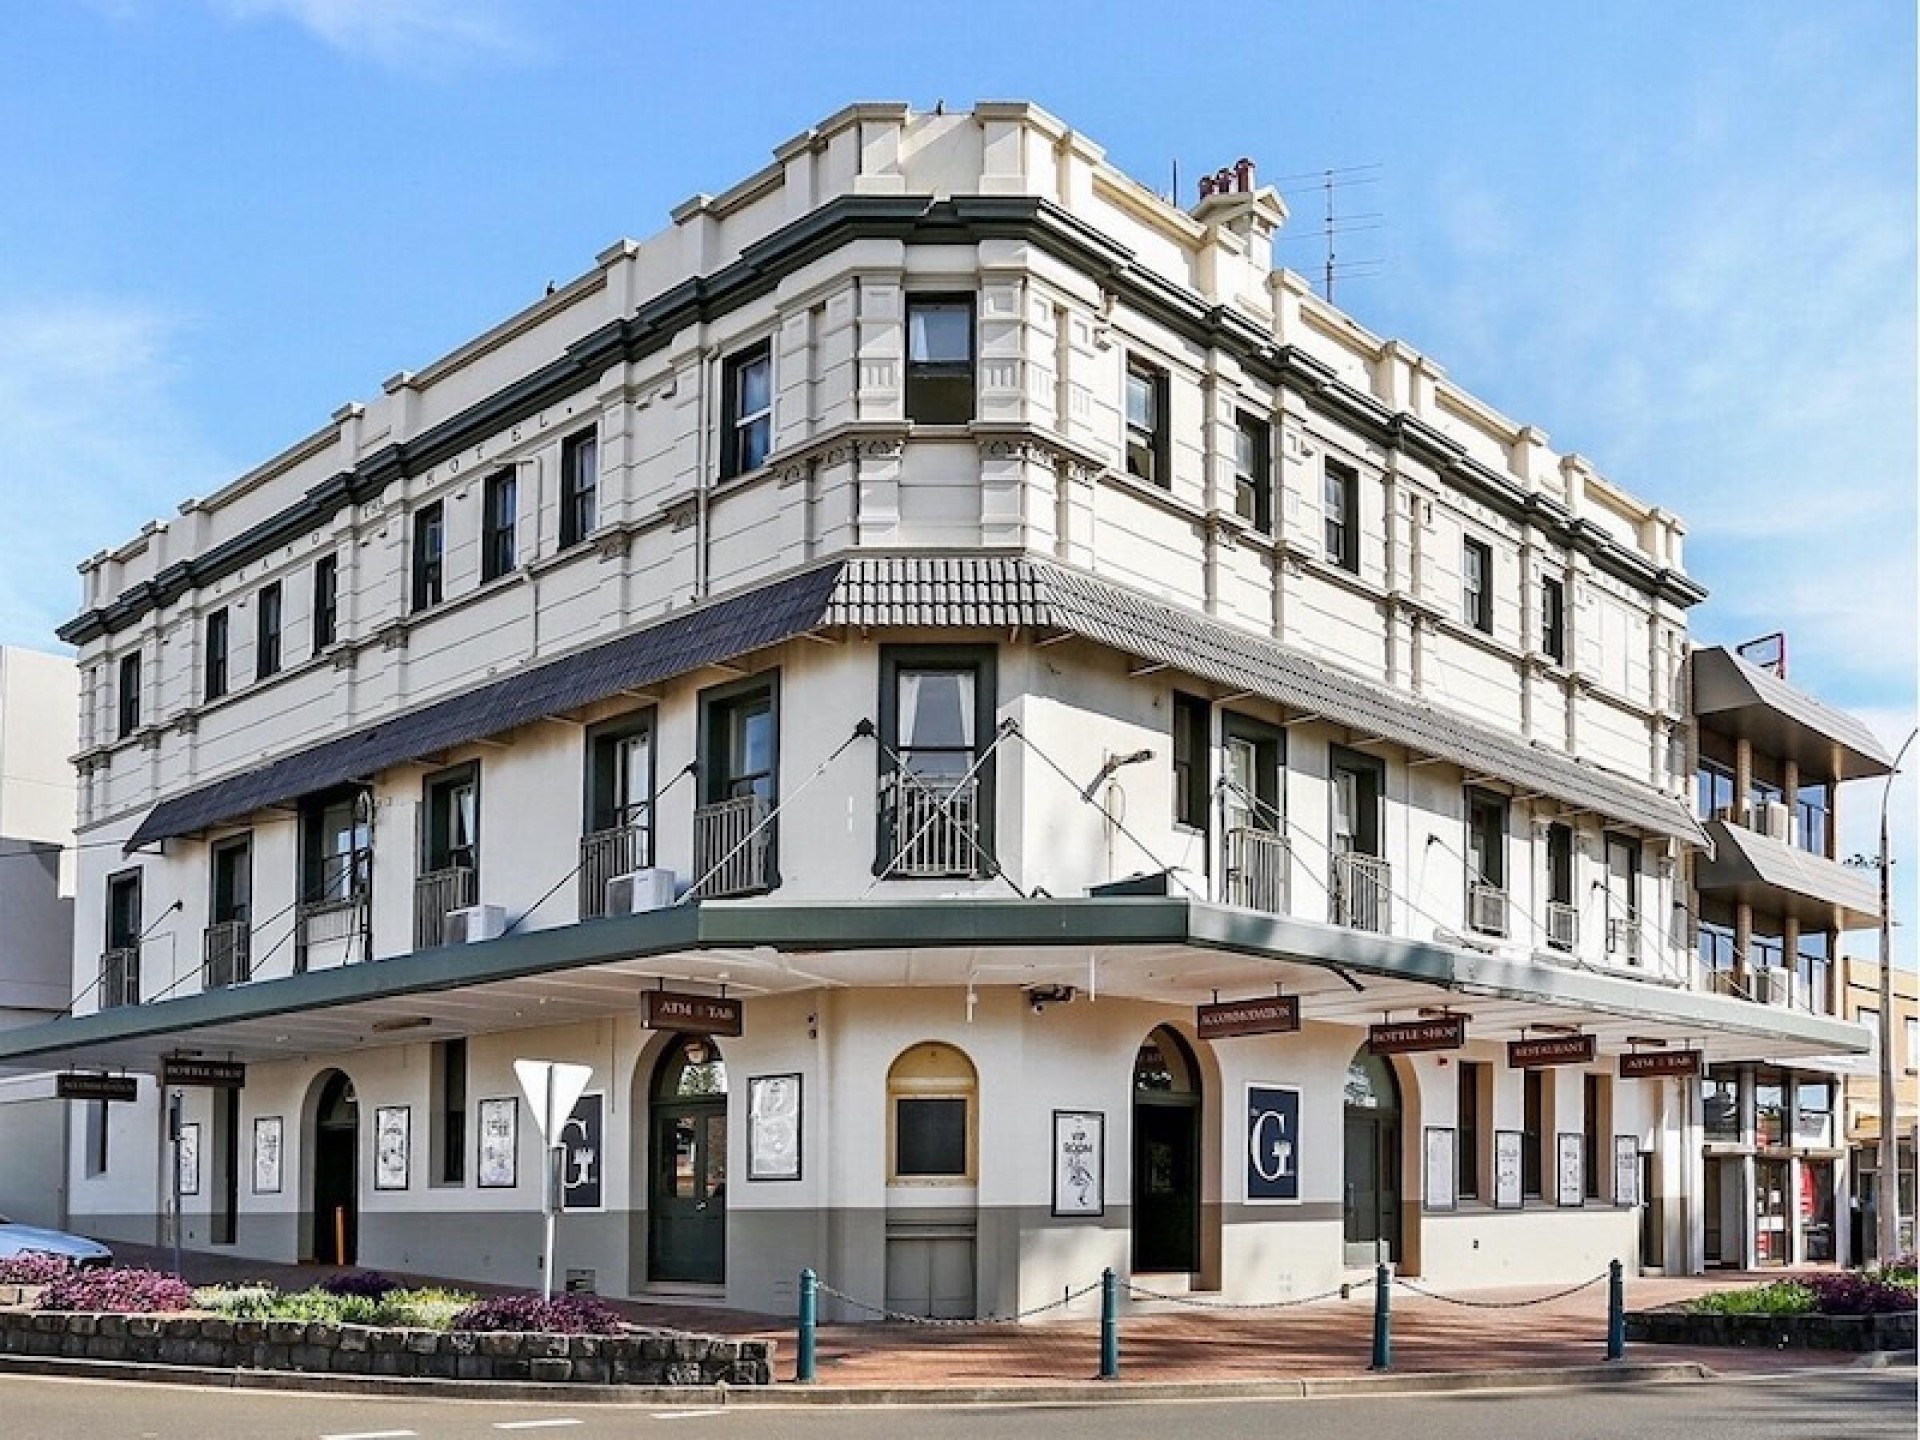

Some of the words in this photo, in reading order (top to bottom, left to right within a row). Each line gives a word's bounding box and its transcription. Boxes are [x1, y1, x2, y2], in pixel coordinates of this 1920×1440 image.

[659, 1001, 692, 1016] ATM
[706, 1005, 735, 1019] TAB
[1201, 1004, 1290, 1026] ACCOMMODATION
[1372, 1028, 1417, 1043] BOTTLE
[1422, 1026, 1458, 1039] SHOP
[1515, 1041, 1584, 1057] RESTAURANT
[167, 1065, 210, 1077] BOTTLE
[213, 1067, 243, 1079] SHOP
[1071, 1132, 1085, 1141] VIP
[1063, 1142, 1093, 1153] ROOM
[1252, 1110, 1291, 1181] G
